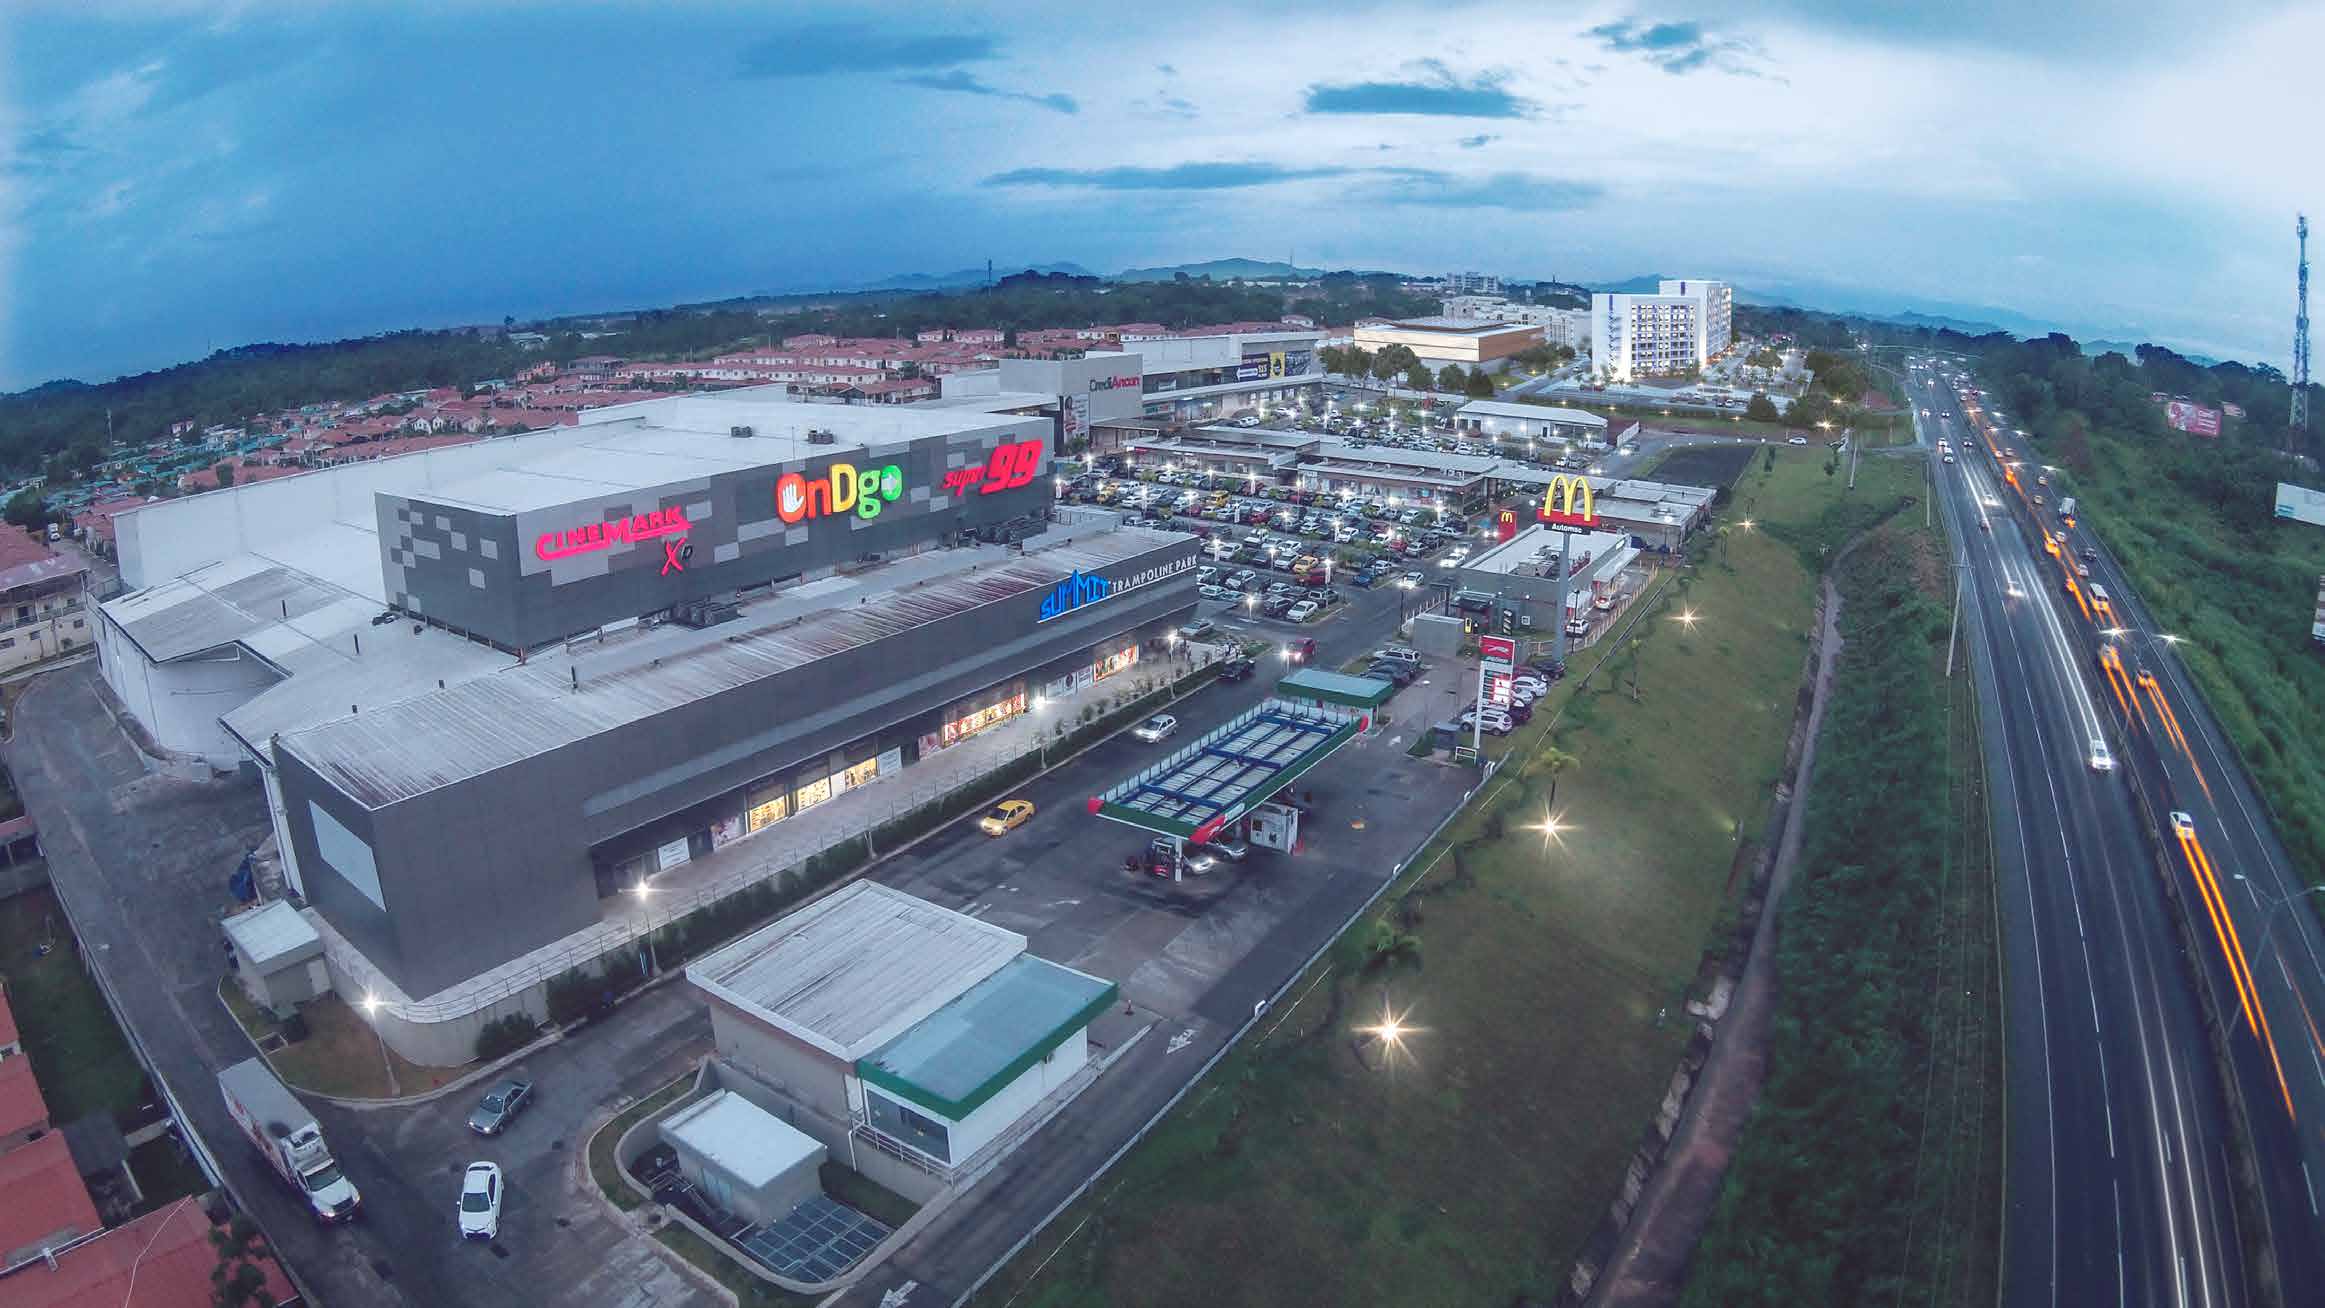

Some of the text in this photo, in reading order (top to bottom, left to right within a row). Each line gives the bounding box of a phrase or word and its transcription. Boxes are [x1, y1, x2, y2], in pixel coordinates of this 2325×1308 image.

[981, 440, 1043, 494] 99
[1039, 554, 1197, 621] SUMMIT TRAMPOLINE PARK
